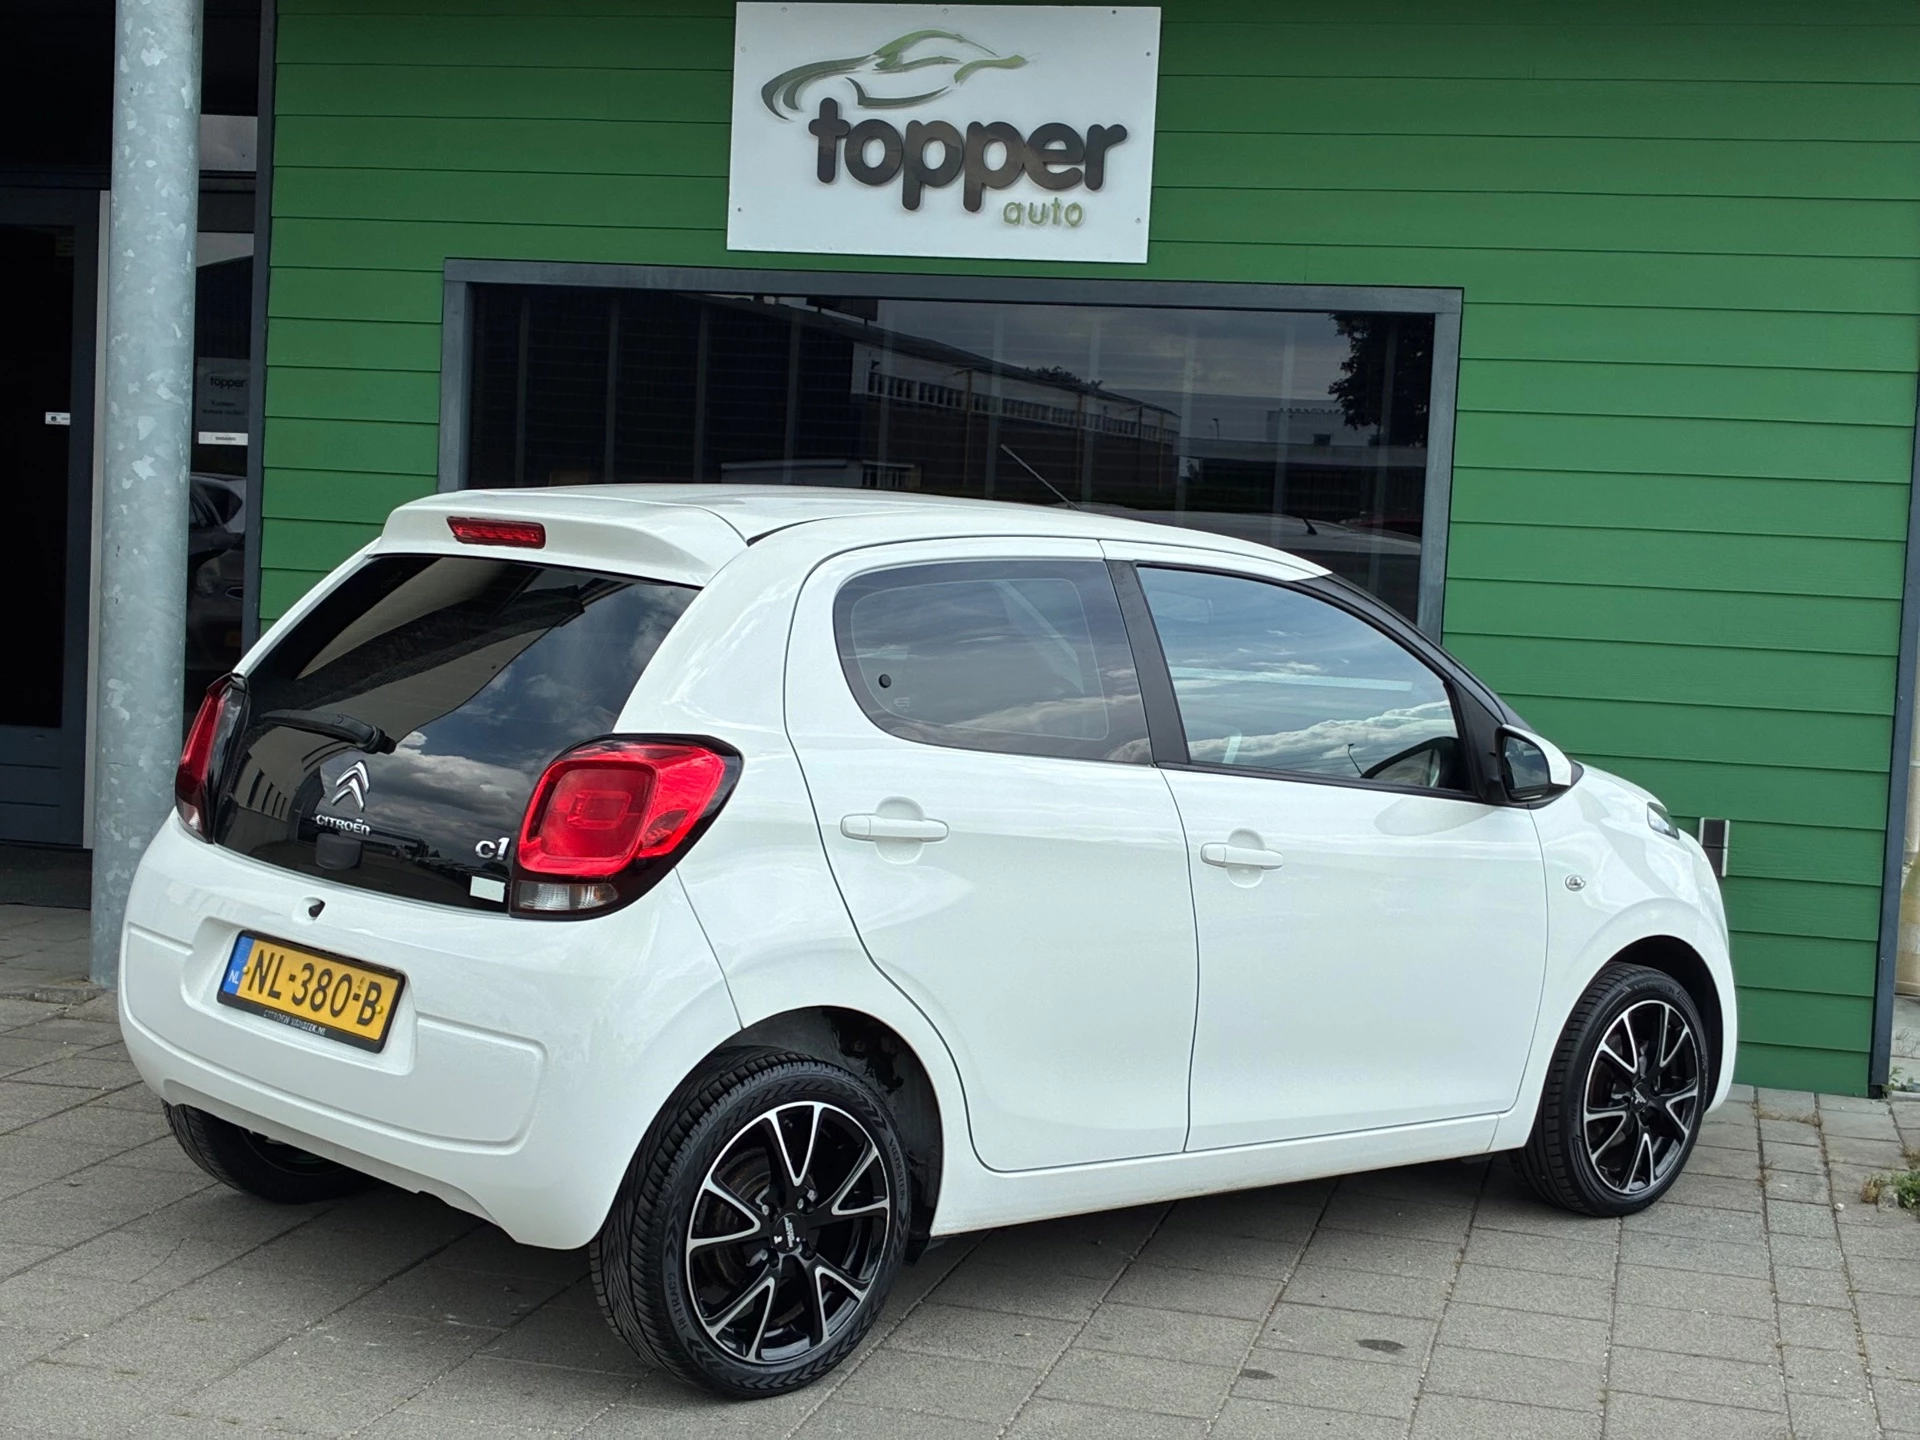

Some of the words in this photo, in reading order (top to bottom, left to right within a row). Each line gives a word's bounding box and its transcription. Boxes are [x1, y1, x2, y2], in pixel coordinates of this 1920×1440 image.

[808, 97, 1128, 213] topper
[1003, 197, 1084, 227] auto
[210, 375, 246, 389] topper
[228, 969, 239, 984] NL
[247, 949, 382, 1026] NL-380-B
